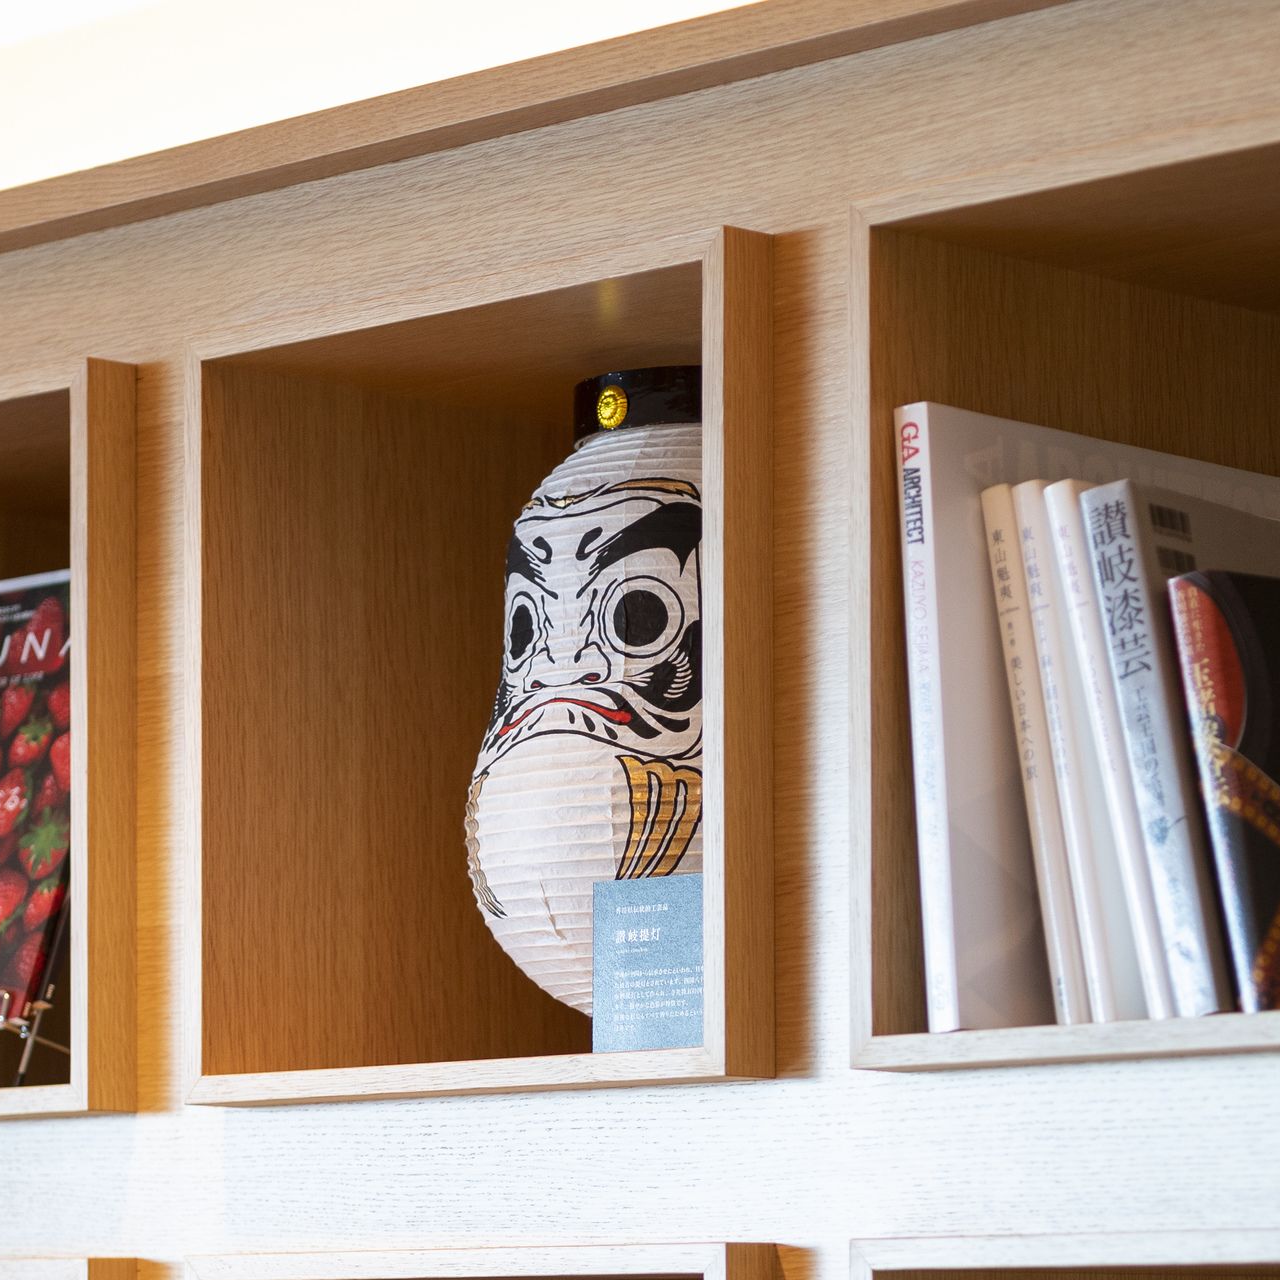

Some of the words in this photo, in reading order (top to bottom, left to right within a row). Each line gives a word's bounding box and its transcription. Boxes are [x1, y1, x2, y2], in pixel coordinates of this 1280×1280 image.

[901, 422, 919, 465] GA
[903, 468, 924, 544] ARCHITECT
[993, 529, 1012, 598] 東山魁夷
[1092, 500, 1152, 680] 讃岐漆芸
